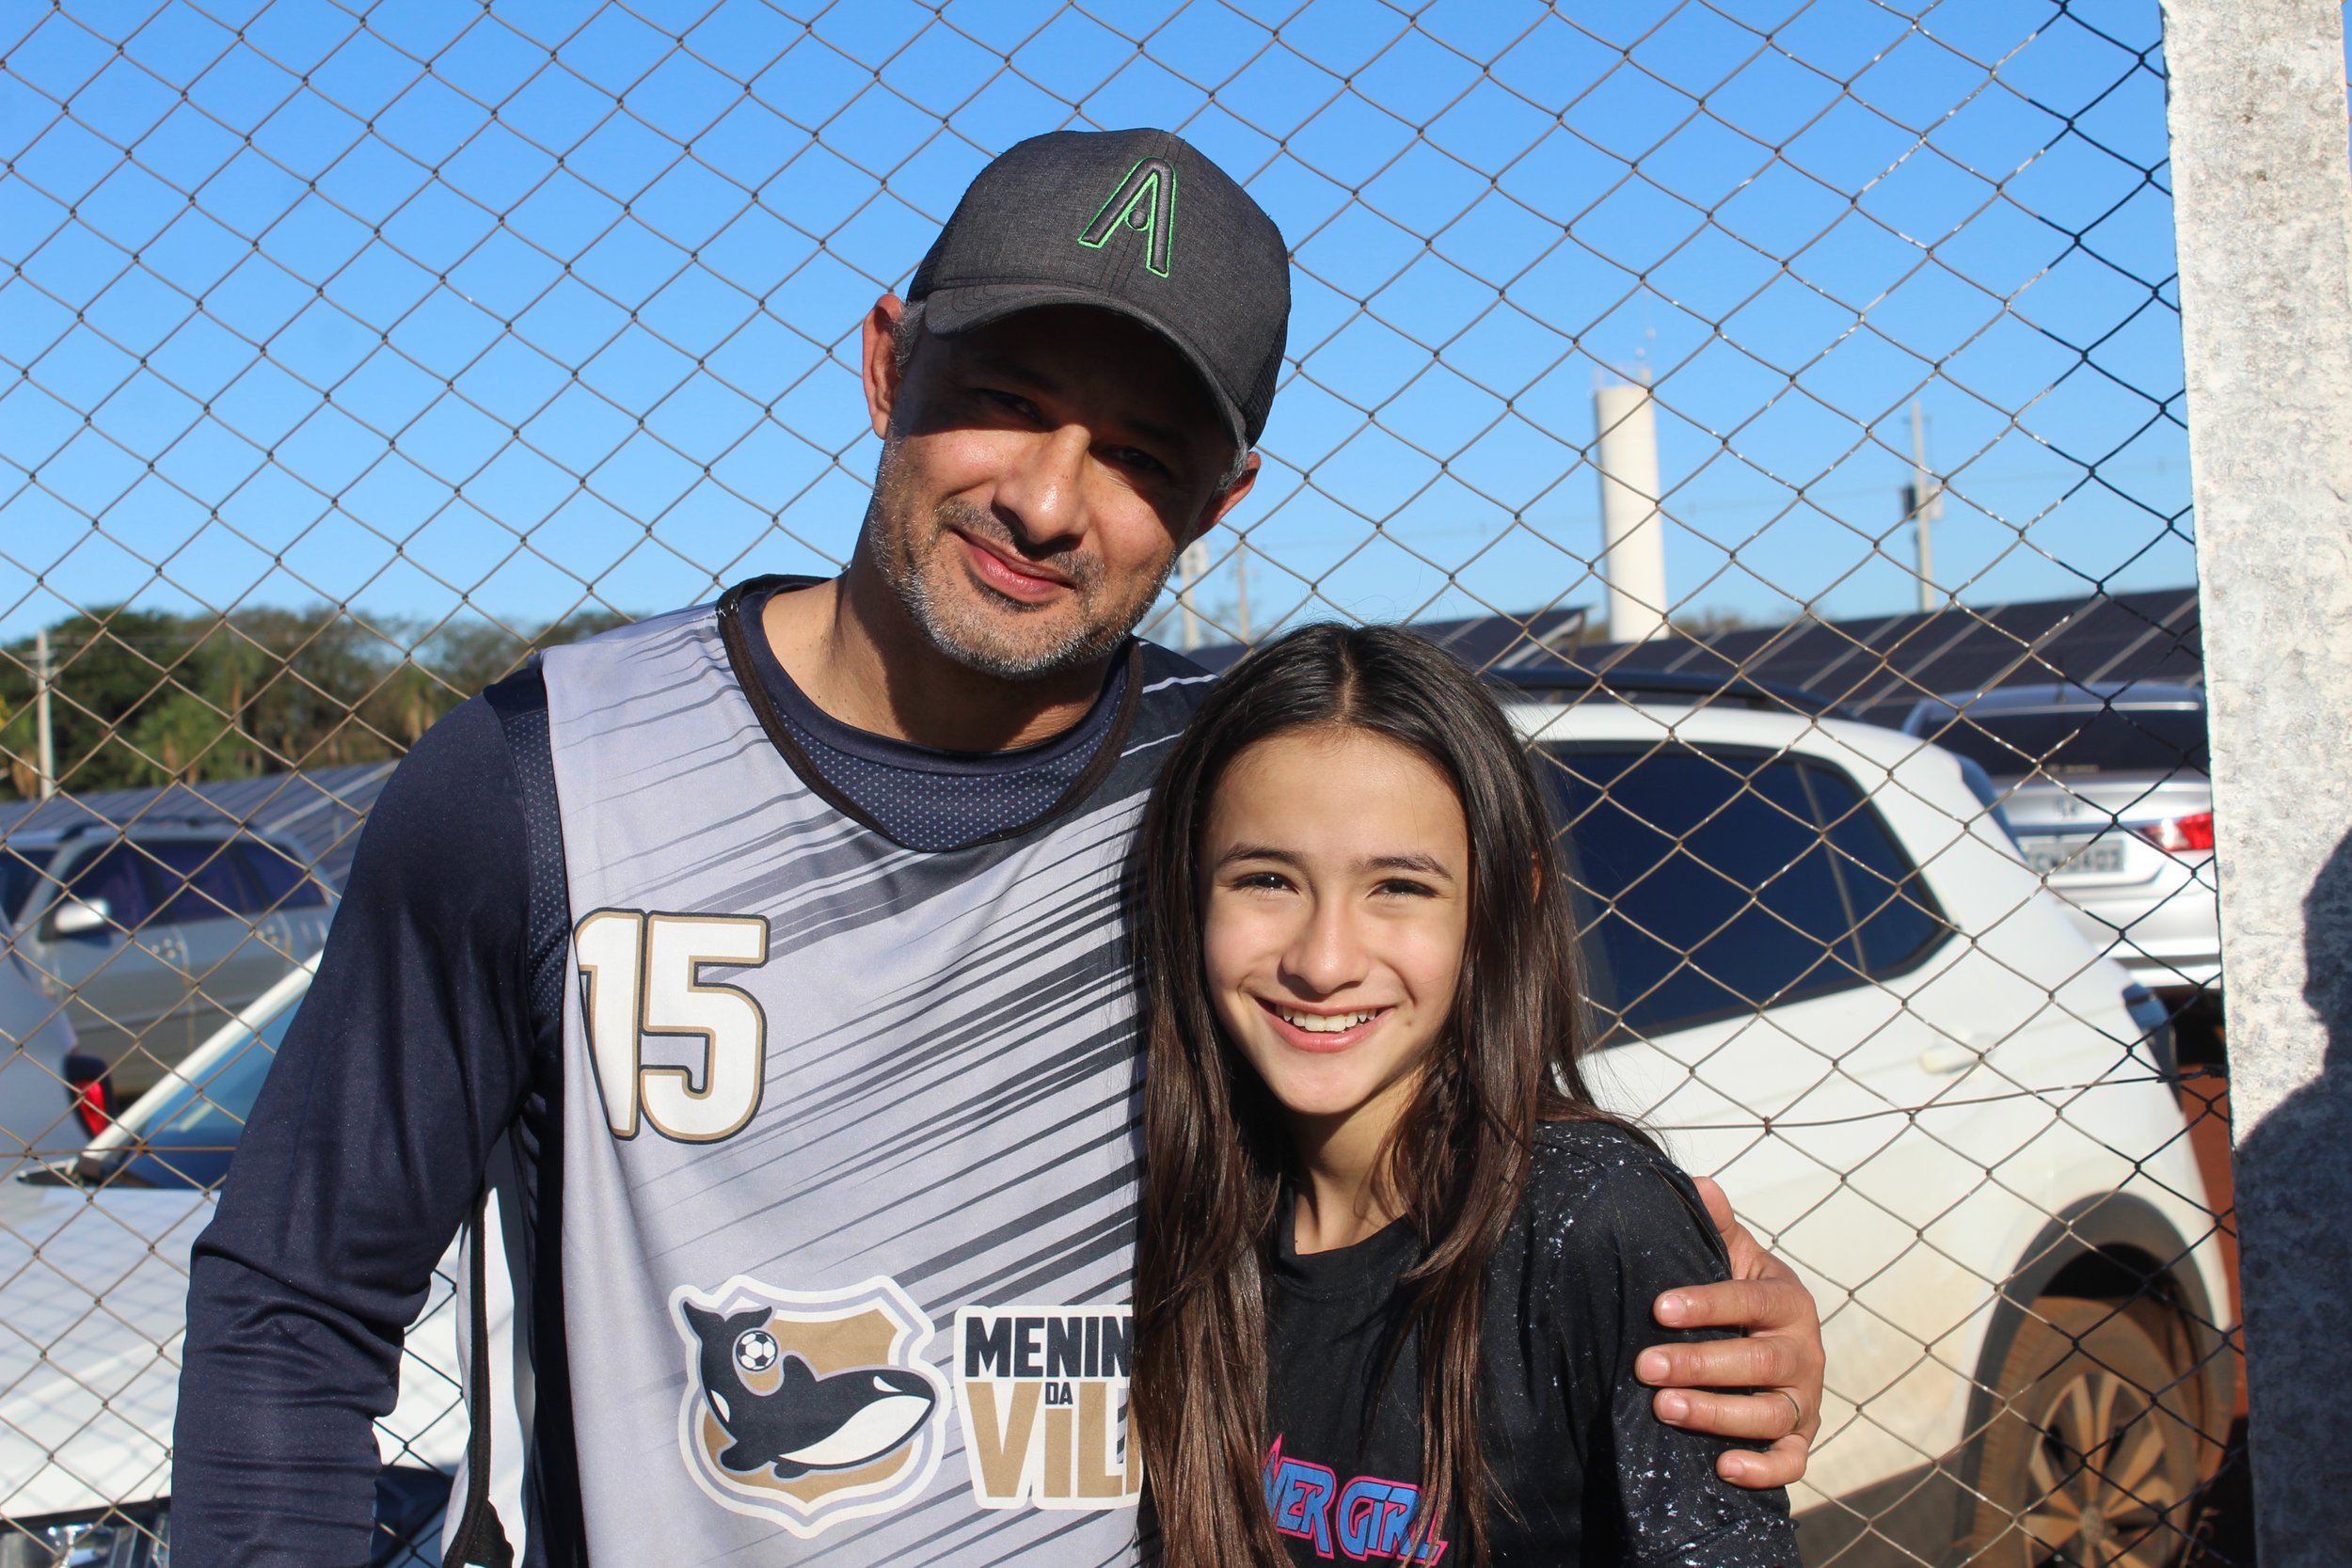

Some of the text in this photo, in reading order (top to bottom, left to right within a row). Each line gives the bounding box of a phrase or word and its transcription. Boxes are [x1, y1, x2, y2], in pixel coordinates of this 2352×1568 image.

[574, 907, 770, 1145] 15
[964, 1316, 1132, 1378] MENIN
[1045, 1382, 1073, 1405] DA
[965, 1381, 1140, 1497] VIL
